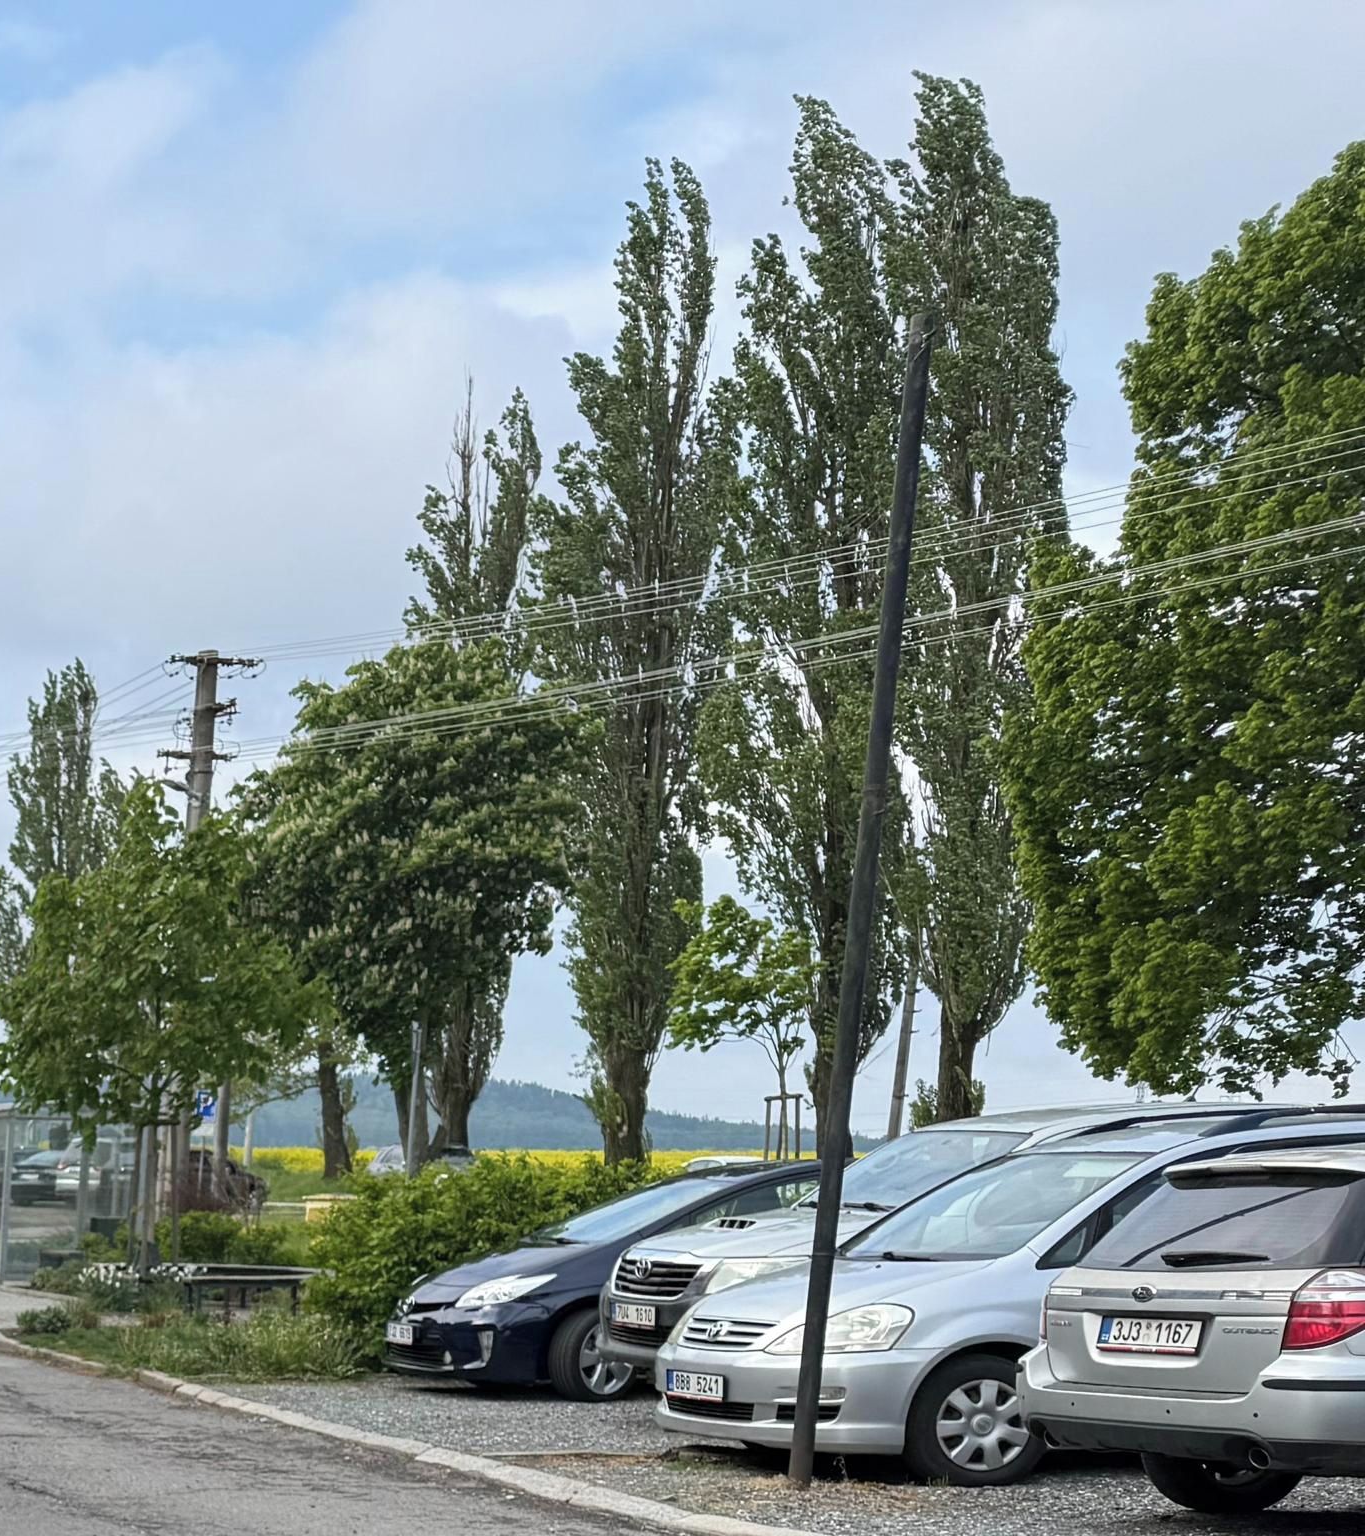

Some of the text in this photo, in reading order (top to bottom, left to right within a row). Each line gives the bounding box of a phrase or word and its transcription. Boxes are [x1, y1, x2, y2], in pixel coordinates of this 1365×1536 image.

[1113, 1321, 1193, 1344] 3J3 1167
[697, 1376, 719, 1394] 5241
